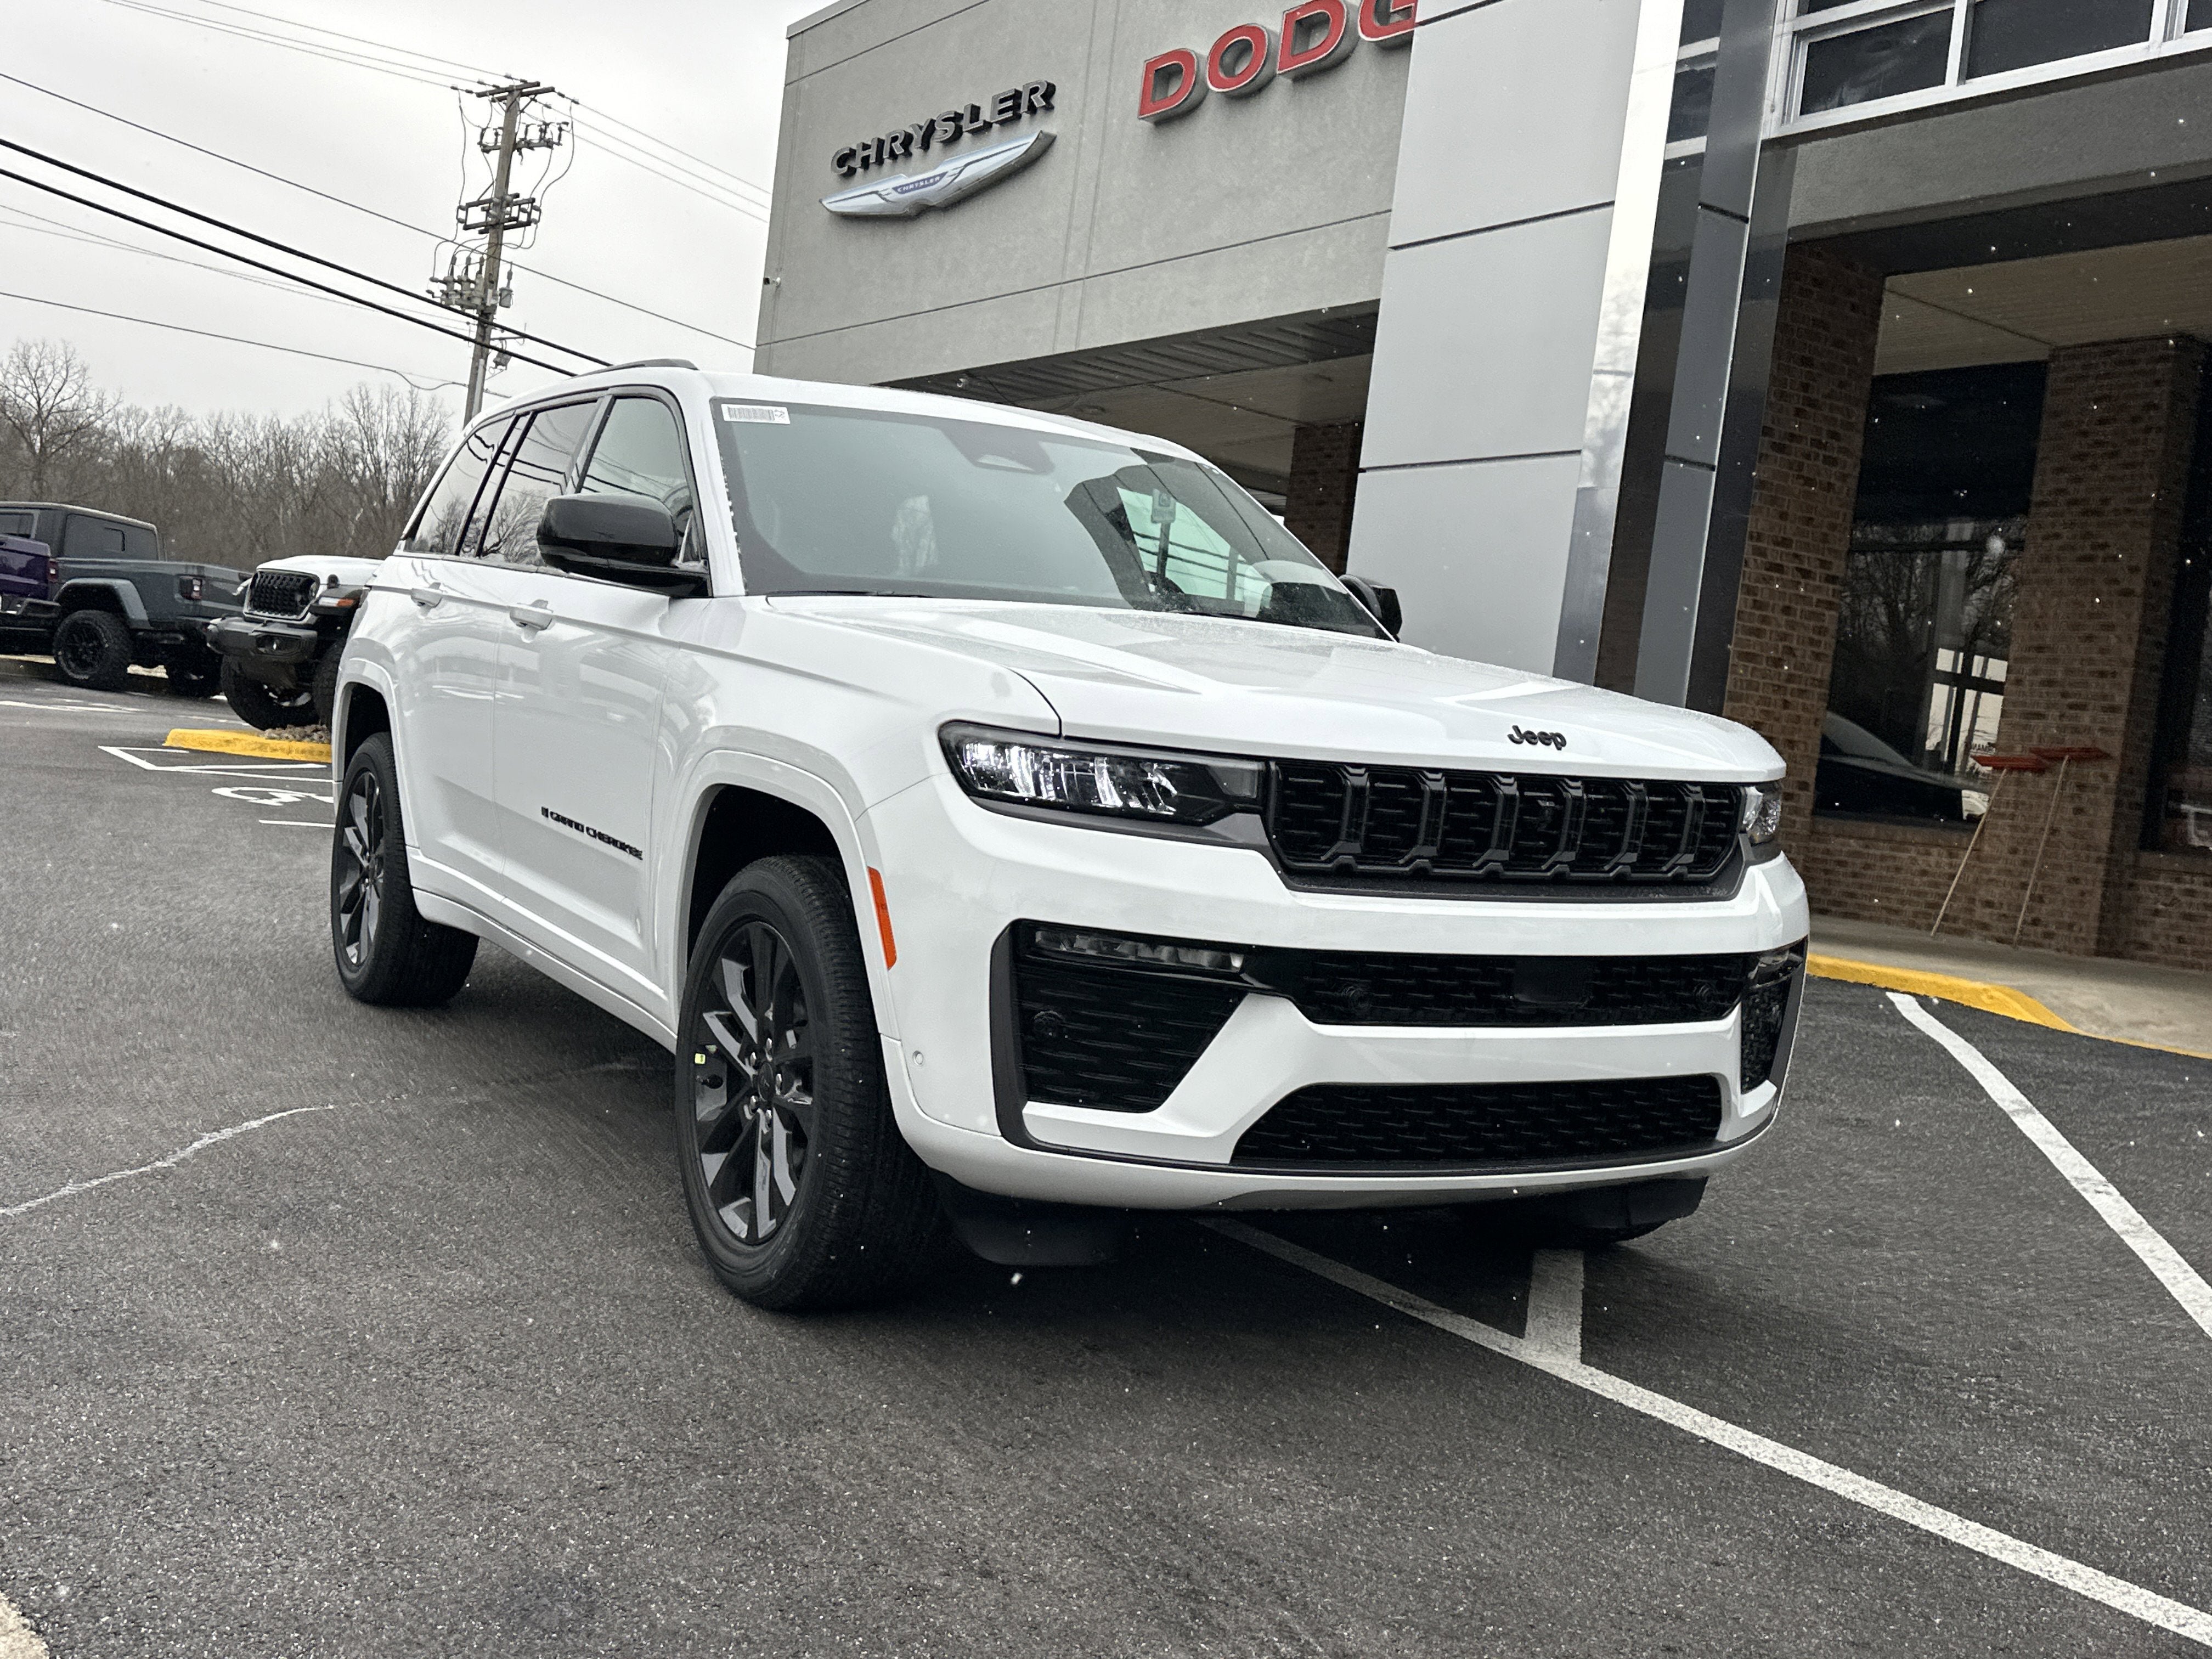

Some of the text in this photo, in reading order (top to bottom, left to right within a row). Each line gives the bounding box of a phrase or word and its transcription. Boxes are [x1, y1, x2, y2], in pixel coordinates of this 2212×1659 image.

[831, 80, 1056, 176] CHRYSLER
[897, 176, 940, 192] CHRYSLER
[1507, 725, 1567, 751] Jeep
